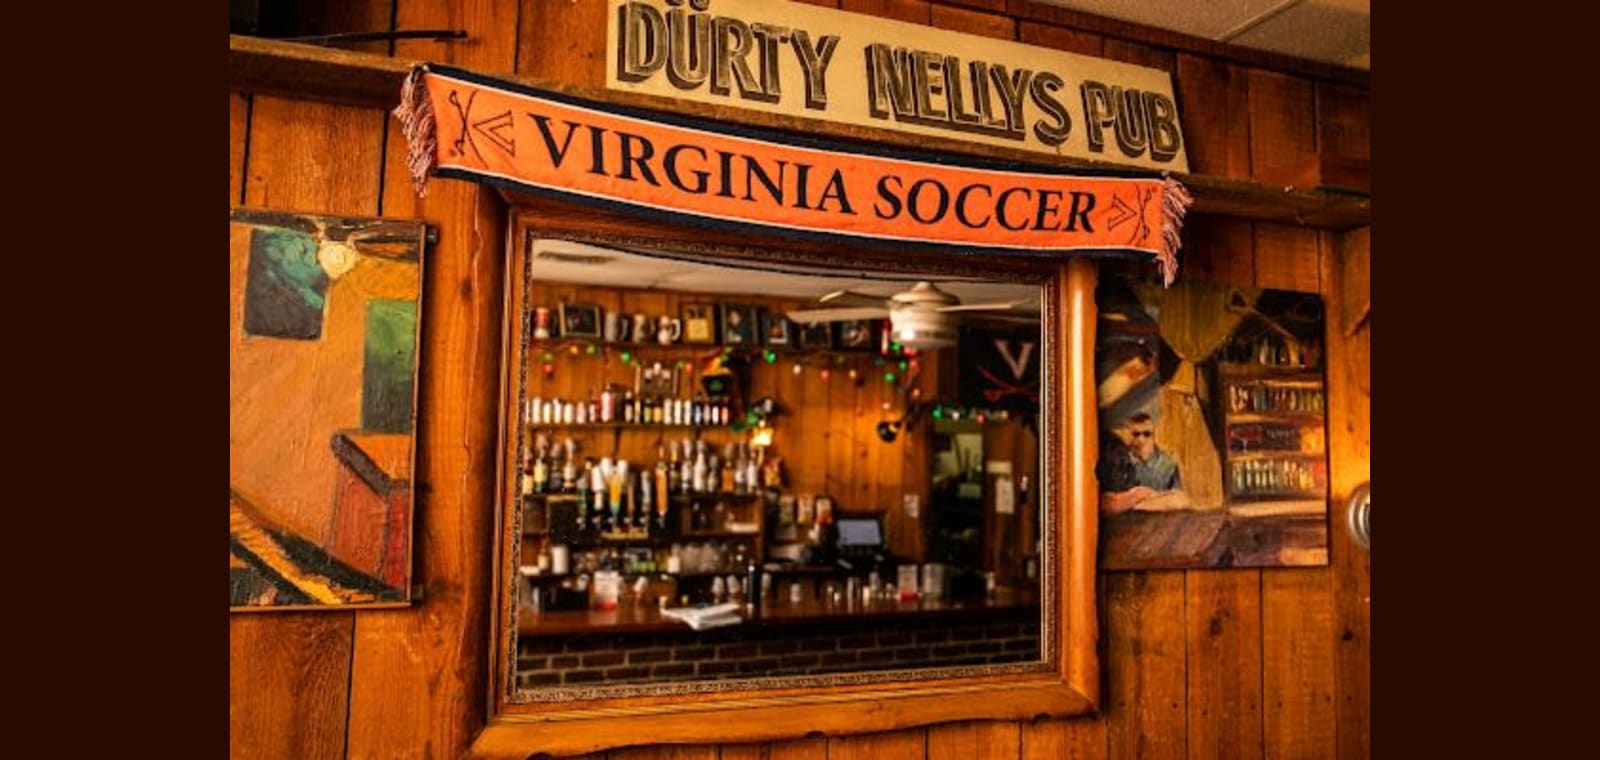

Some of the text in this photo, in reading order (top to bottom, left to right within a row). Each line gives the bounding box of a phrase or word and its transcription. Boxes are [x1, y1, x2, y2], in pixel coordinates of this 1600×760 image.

[617, 0, 1181, 162] DÜRTY NELLYS PUB
[526, 112, 1097, 233] VIRGINIA SOCCER
[994, 339, 1034, 380] V
